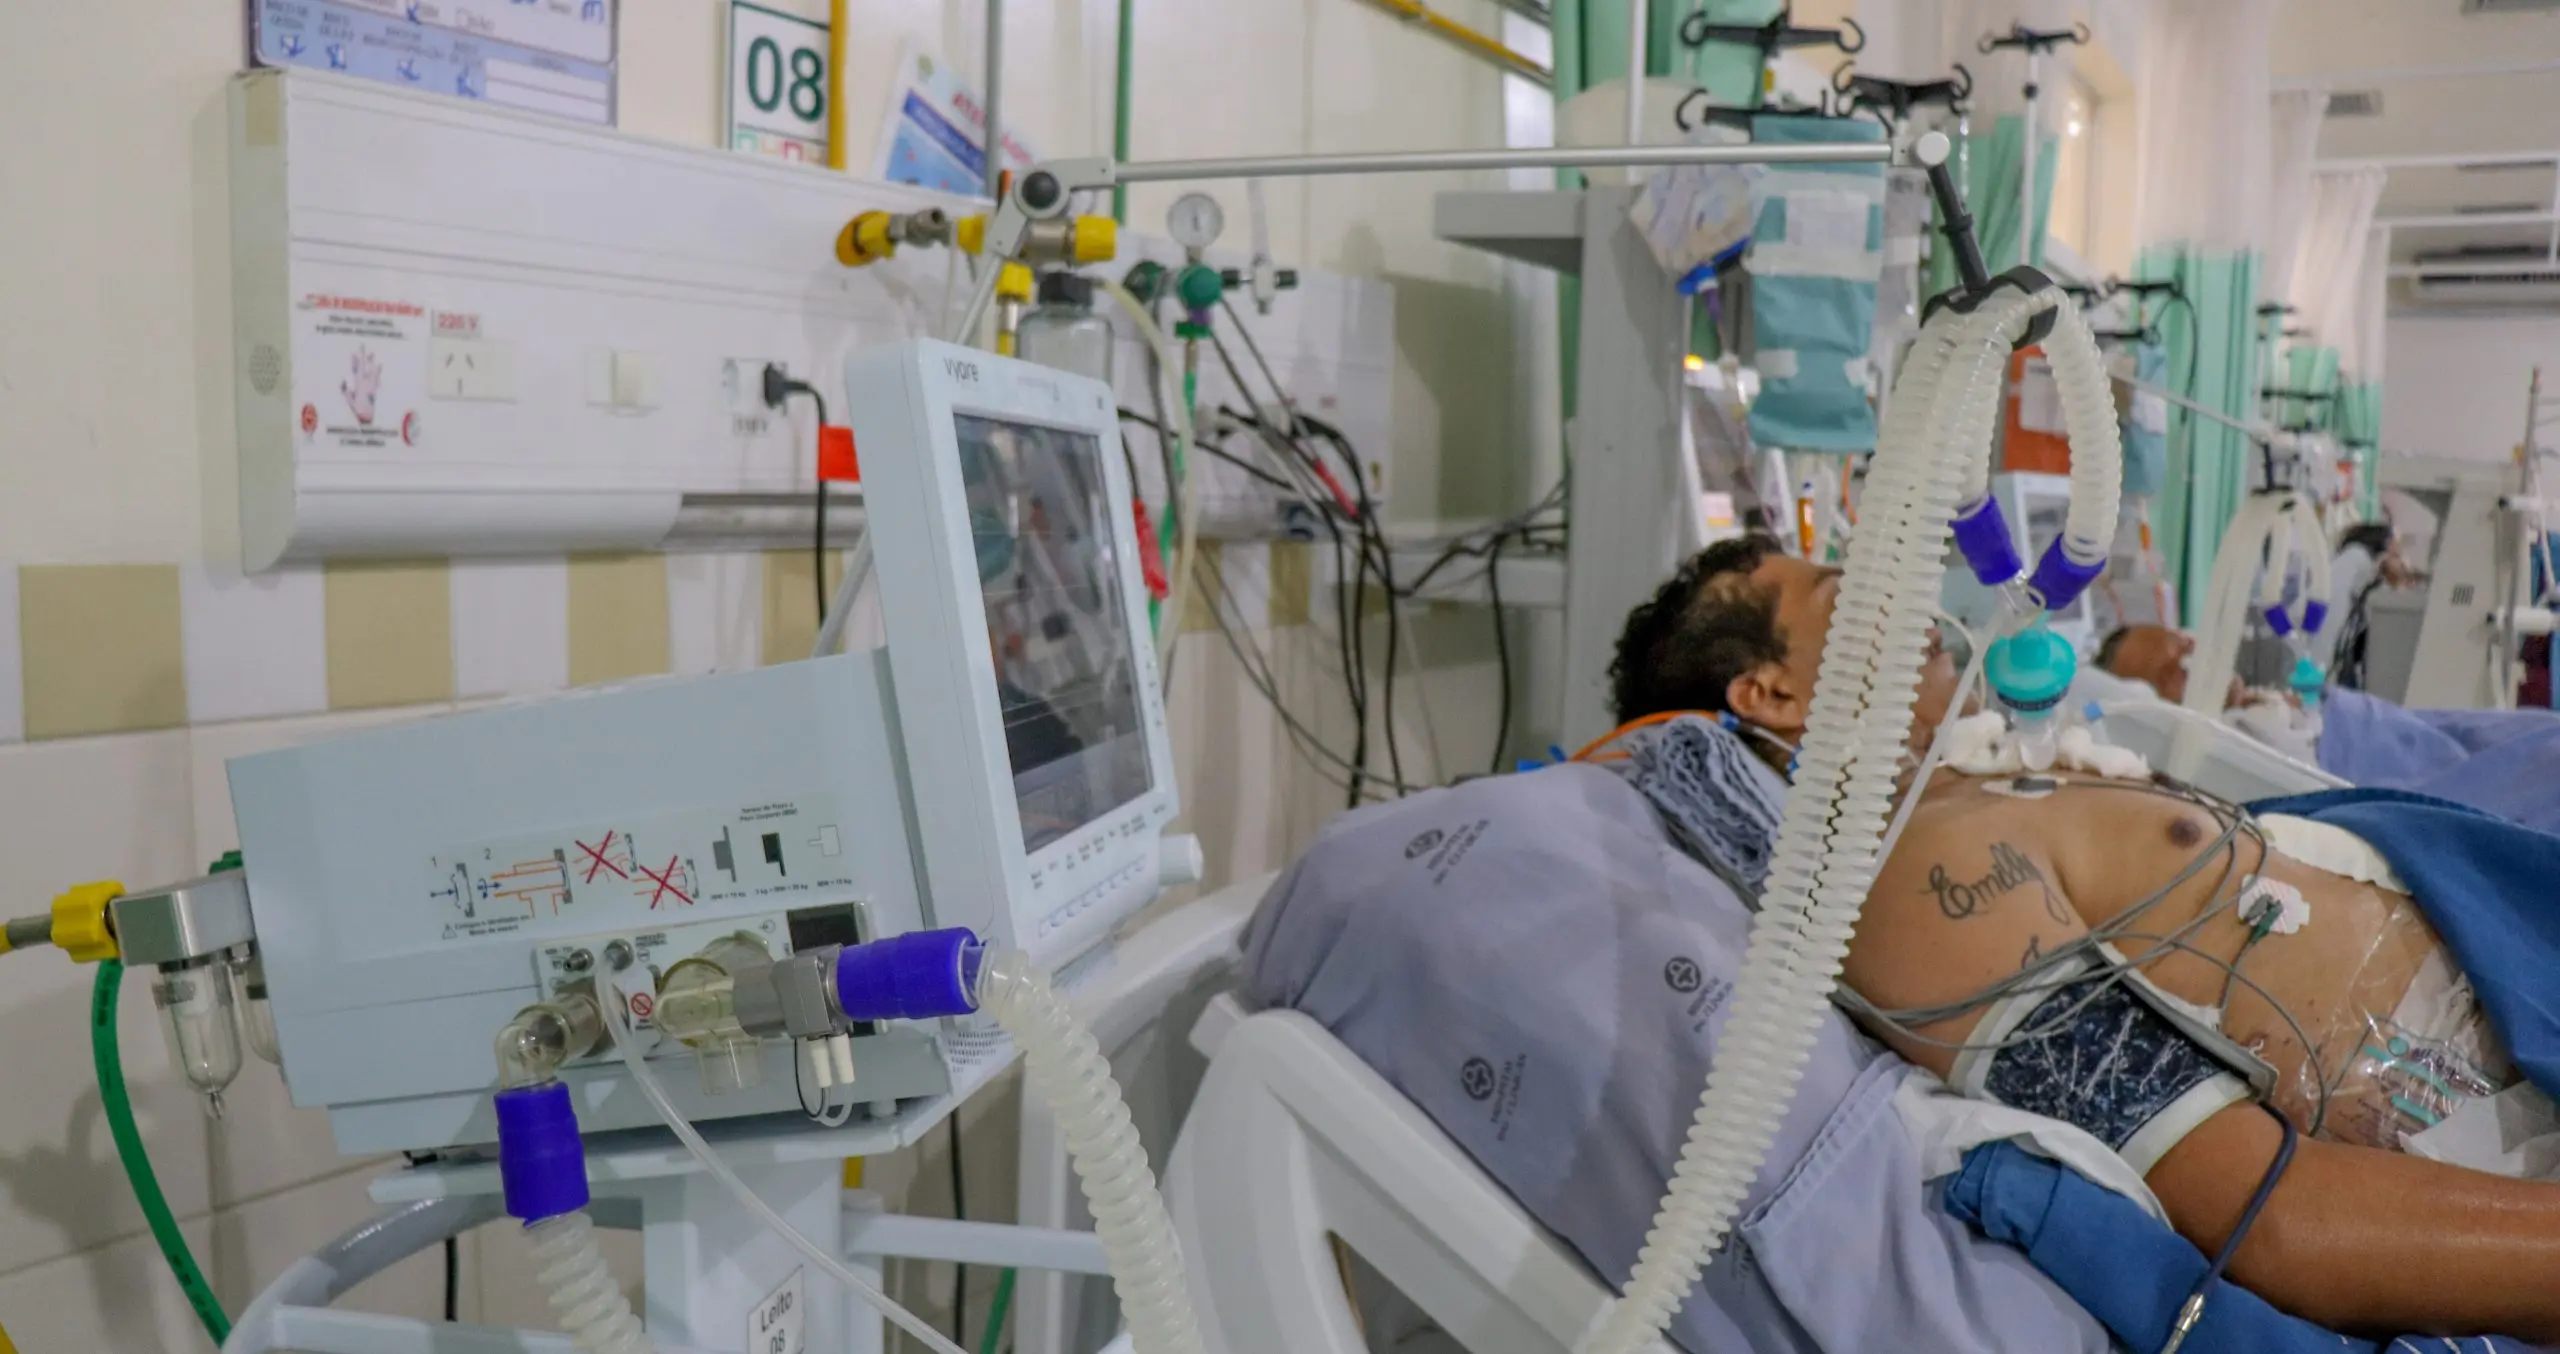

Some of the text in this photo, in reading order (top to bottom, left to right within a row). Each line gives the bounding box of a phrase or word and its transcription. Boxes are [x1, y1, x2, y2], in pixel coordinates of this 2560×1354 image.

[746, 35, 825, 123] 08
[483, 847, 493, 861] 2
[761, 1291, 793, 1332] Leito
